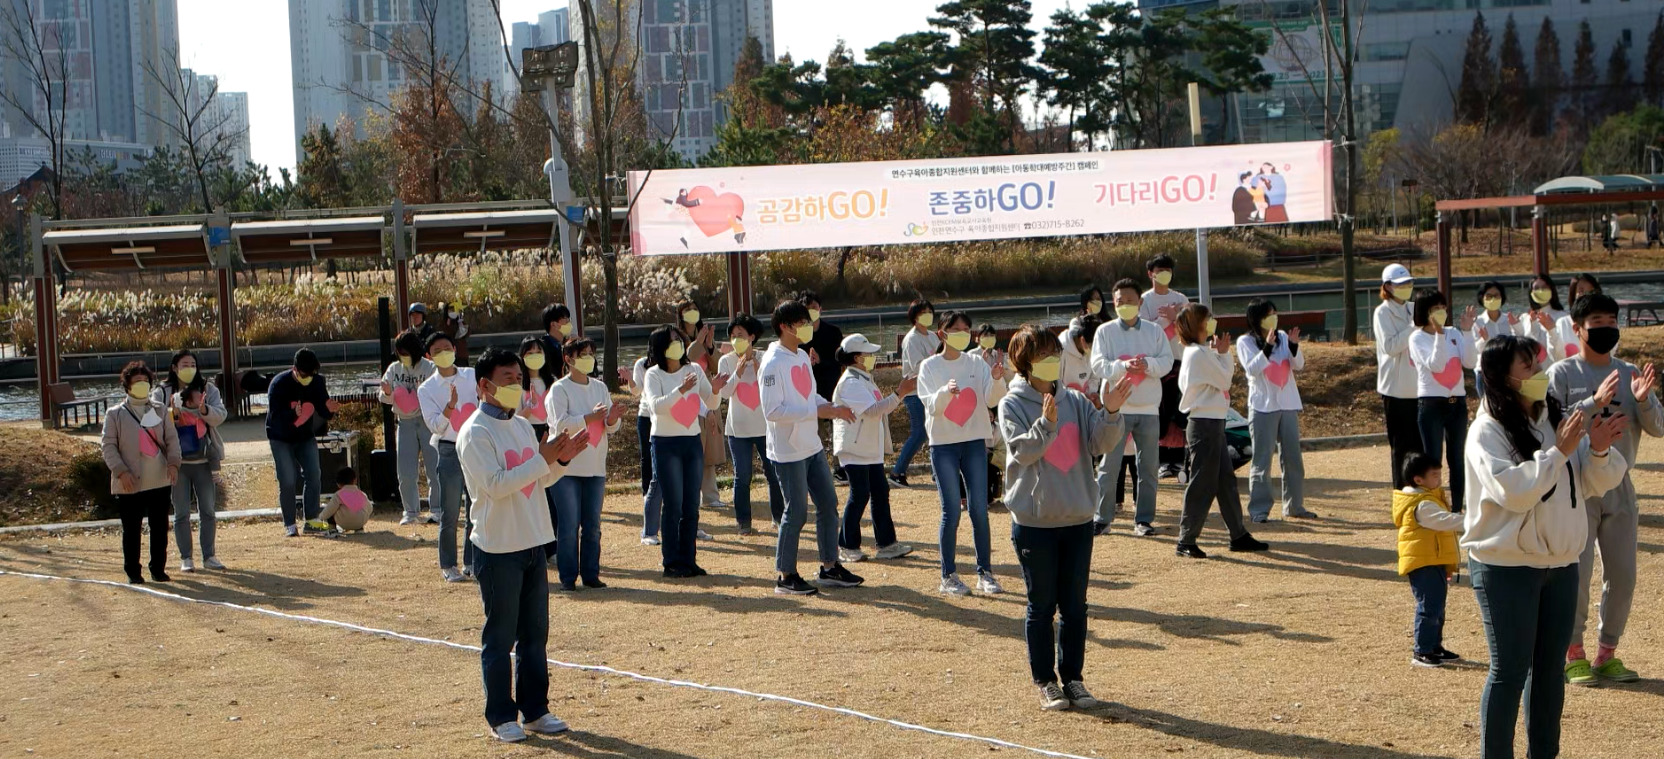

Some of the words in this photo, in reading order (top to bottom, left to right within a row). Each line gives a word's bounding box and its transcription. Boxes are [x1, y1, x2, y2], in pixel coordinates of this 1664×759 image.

[891, 165, 980, 178] 연수구육아종합지원센터와
[981, 164, 1011, 175] 함께하는
[1077, 160, 1099, 171] 캠페인
[757, 188, 888, 224] 공감하GO!
[929, 180, 1056, 215] 존중하GO!
[1094, 173, 1217, 206] 기다리GO!
